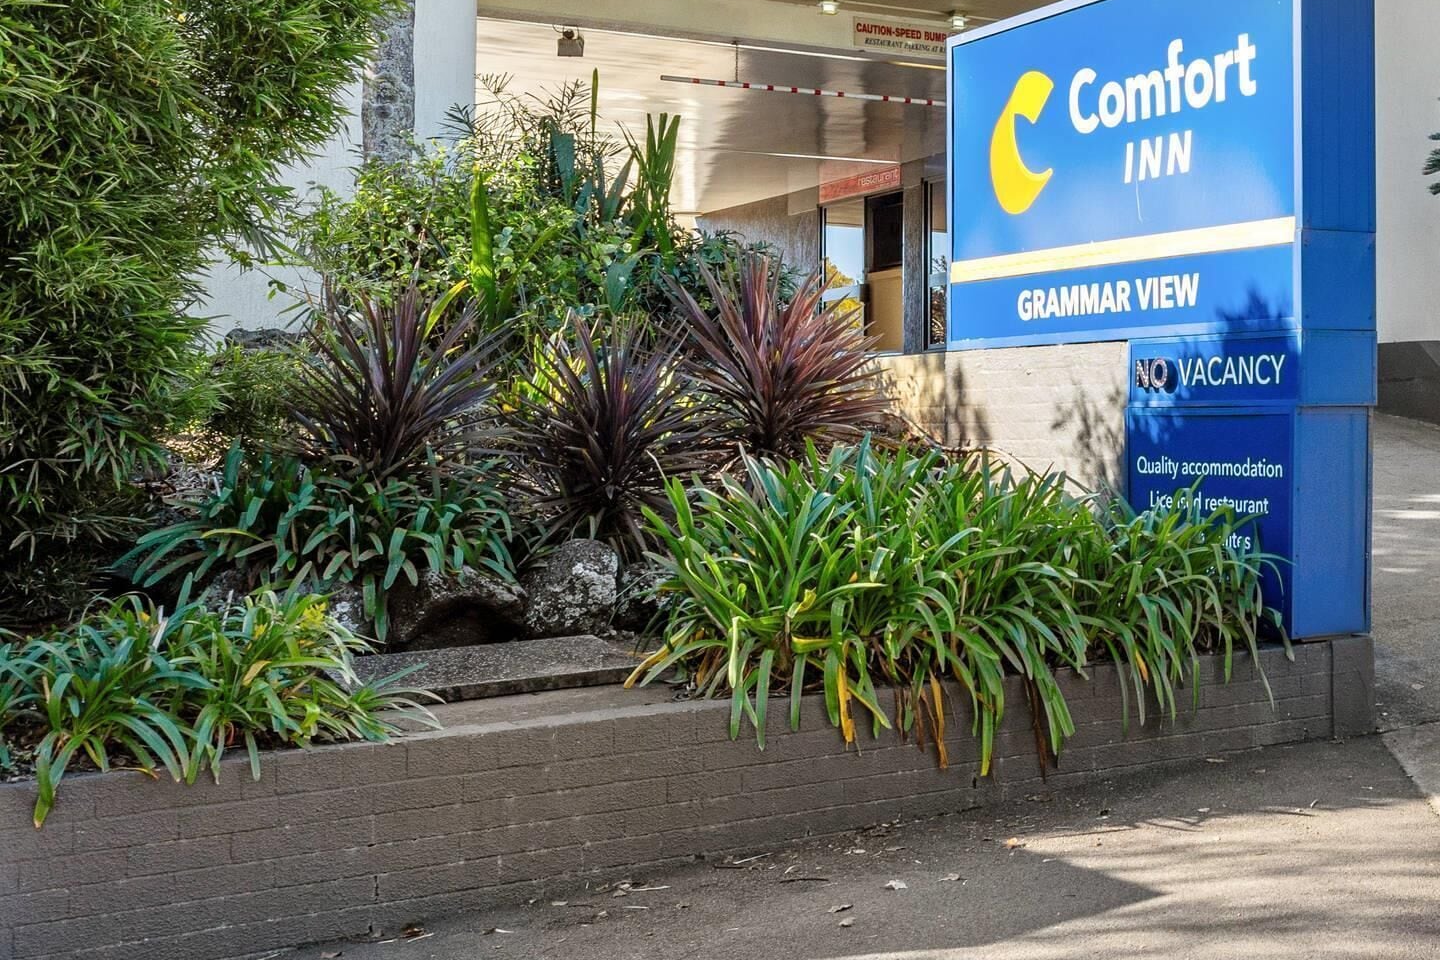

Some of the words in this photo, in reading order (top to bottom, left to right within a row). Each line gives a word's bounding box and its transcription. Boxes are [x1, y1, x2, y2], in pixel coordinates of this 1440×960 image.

[856, 22, 922, 40] CAUTION-SPEED
[864, 37, 903, 48] RESTAURANT
[1068, 33, 1257, 134] Comfort
[1123, 130, 1192, 184] INN
[857, 168, 898, 186] restaurant
[1017, 282, 1131, 321] GRAMMAR
[1135, 273, 1200, 311] VIEW
[1135, 357, 1168, 389] NO
[1178, 354, 1286, 386] VACANCY
[1136, 455, 1179, 480] Quality
[1181, 457, 1283, 478] accommodation
